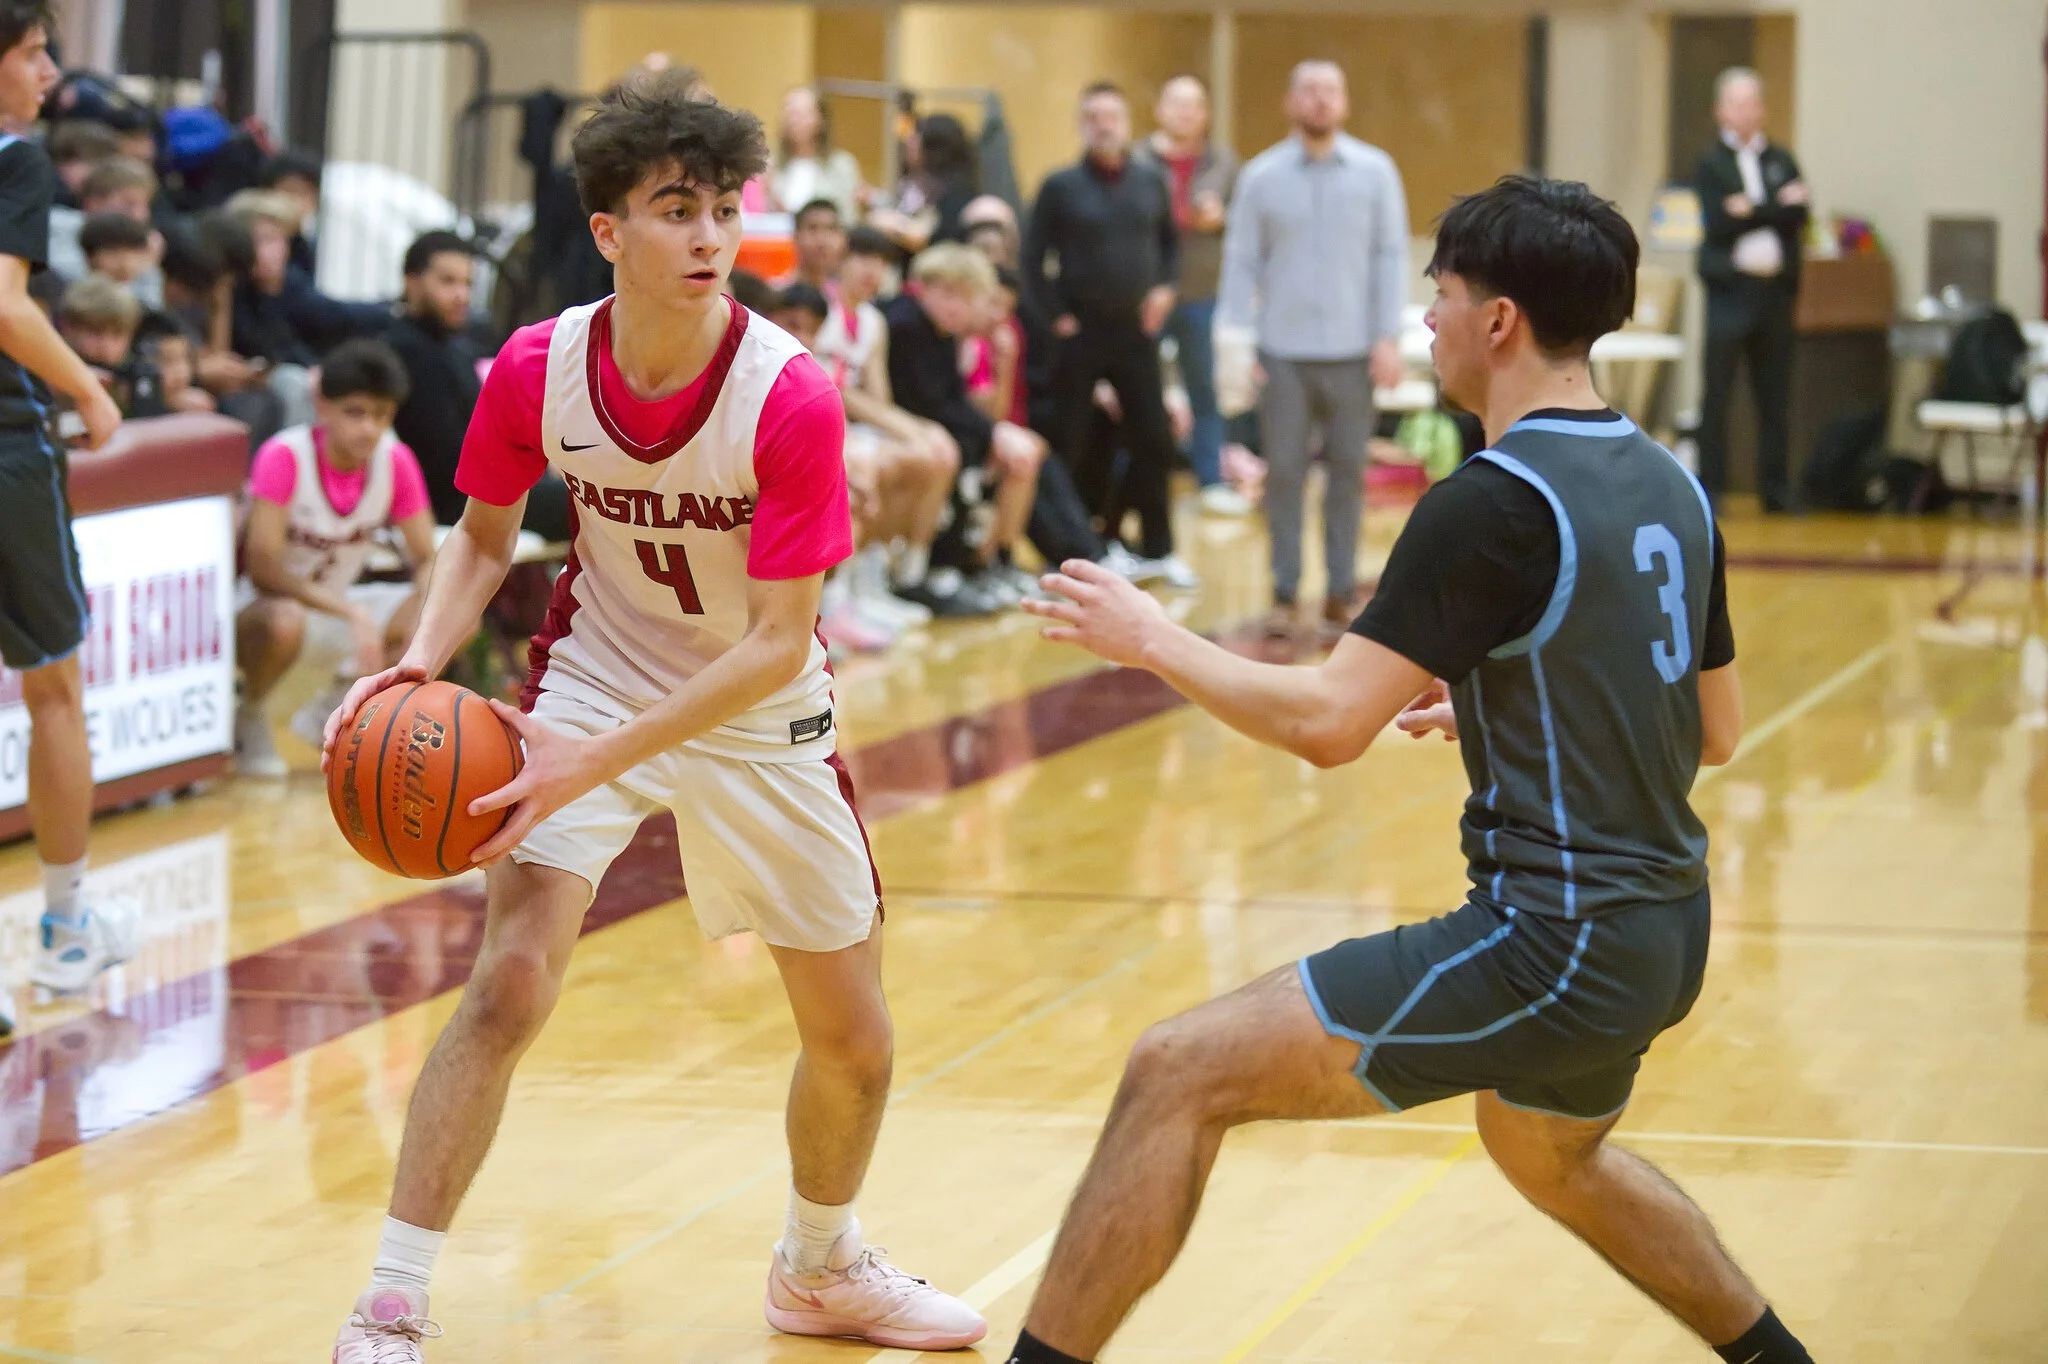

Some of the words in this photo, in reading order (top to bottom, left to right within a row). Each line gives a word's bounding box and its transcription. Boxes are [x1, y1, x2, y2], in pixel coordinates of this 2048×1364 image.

[561, 468, 755, 532] EASTLAKE
[633, 538, 705, 615] 4
[1632, 523, 1692, 684] 3
[403, 711, 446, 839] Baden
